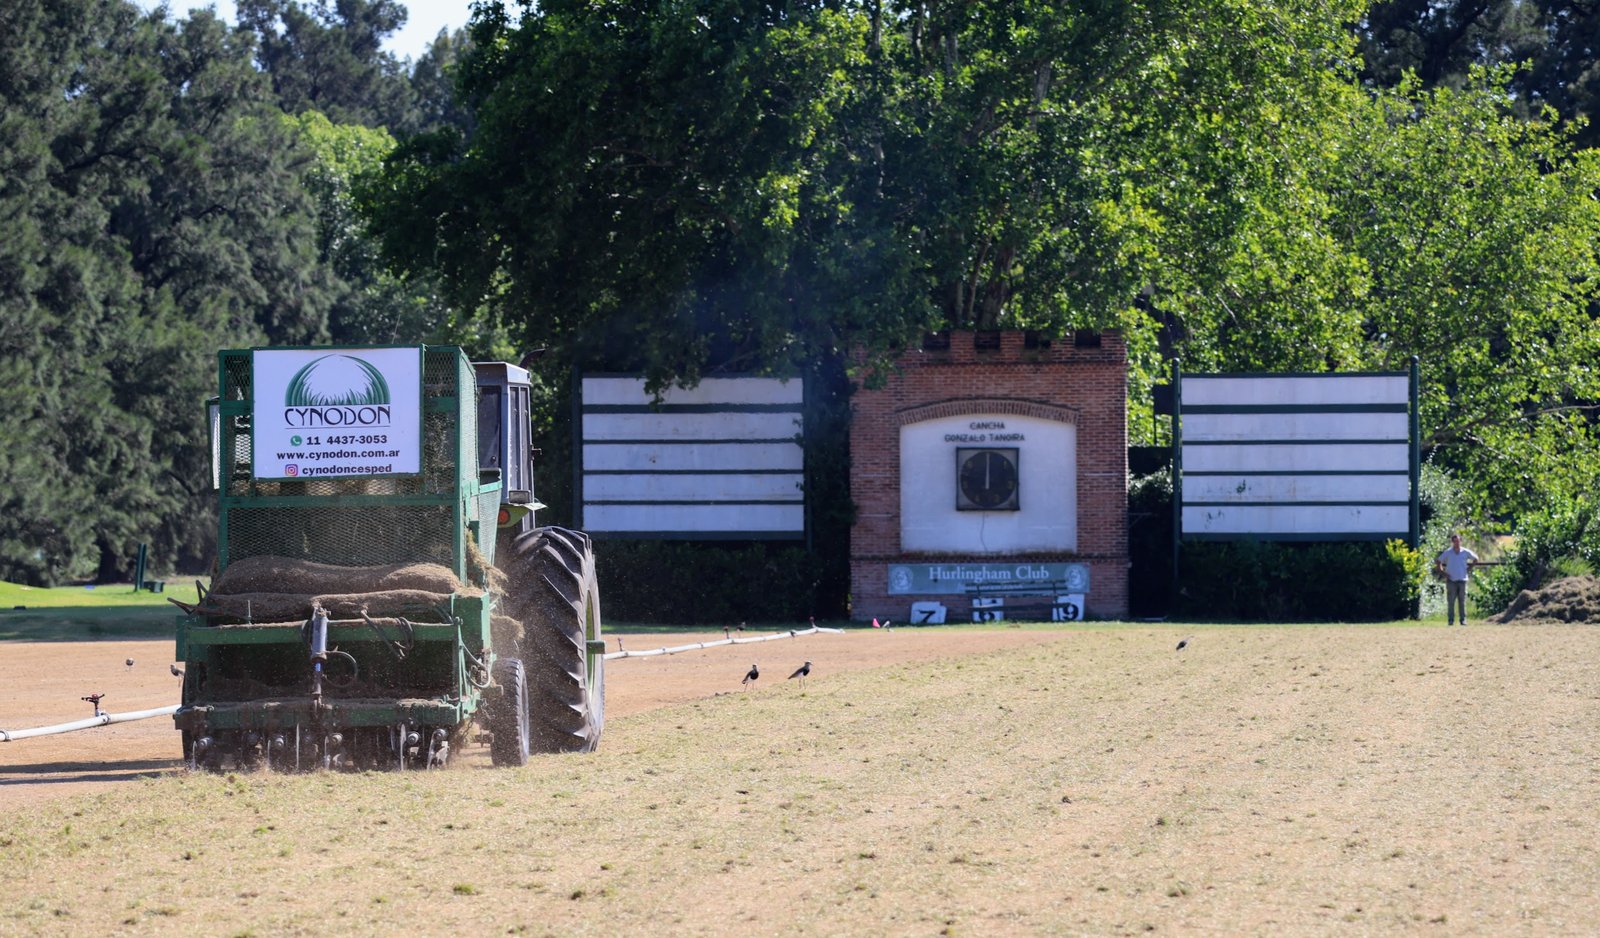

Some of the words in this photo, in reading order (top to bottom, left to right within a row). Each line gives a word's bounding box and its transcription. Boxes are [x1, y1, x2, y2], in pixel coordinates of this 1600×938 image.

[284, 406, 391, 426] CYNODON
[969, 422, 1005, 430] CANCHA
[306, 436, 321, 446] 11
[326, 435, 388, 445] 4437-3053
[944, 433, 986, 442] GONZALO
[276, 449, 400, 461] www.cynodon.com.ar
[302, 464, 392, 475] cynodoncesped
[929, 566, 1012, 584] Hurlingham
[1015, 565, 1050, 579] Club
[916, 609, 936, 623] 7
[1062, 603, 1079, 621] 9
